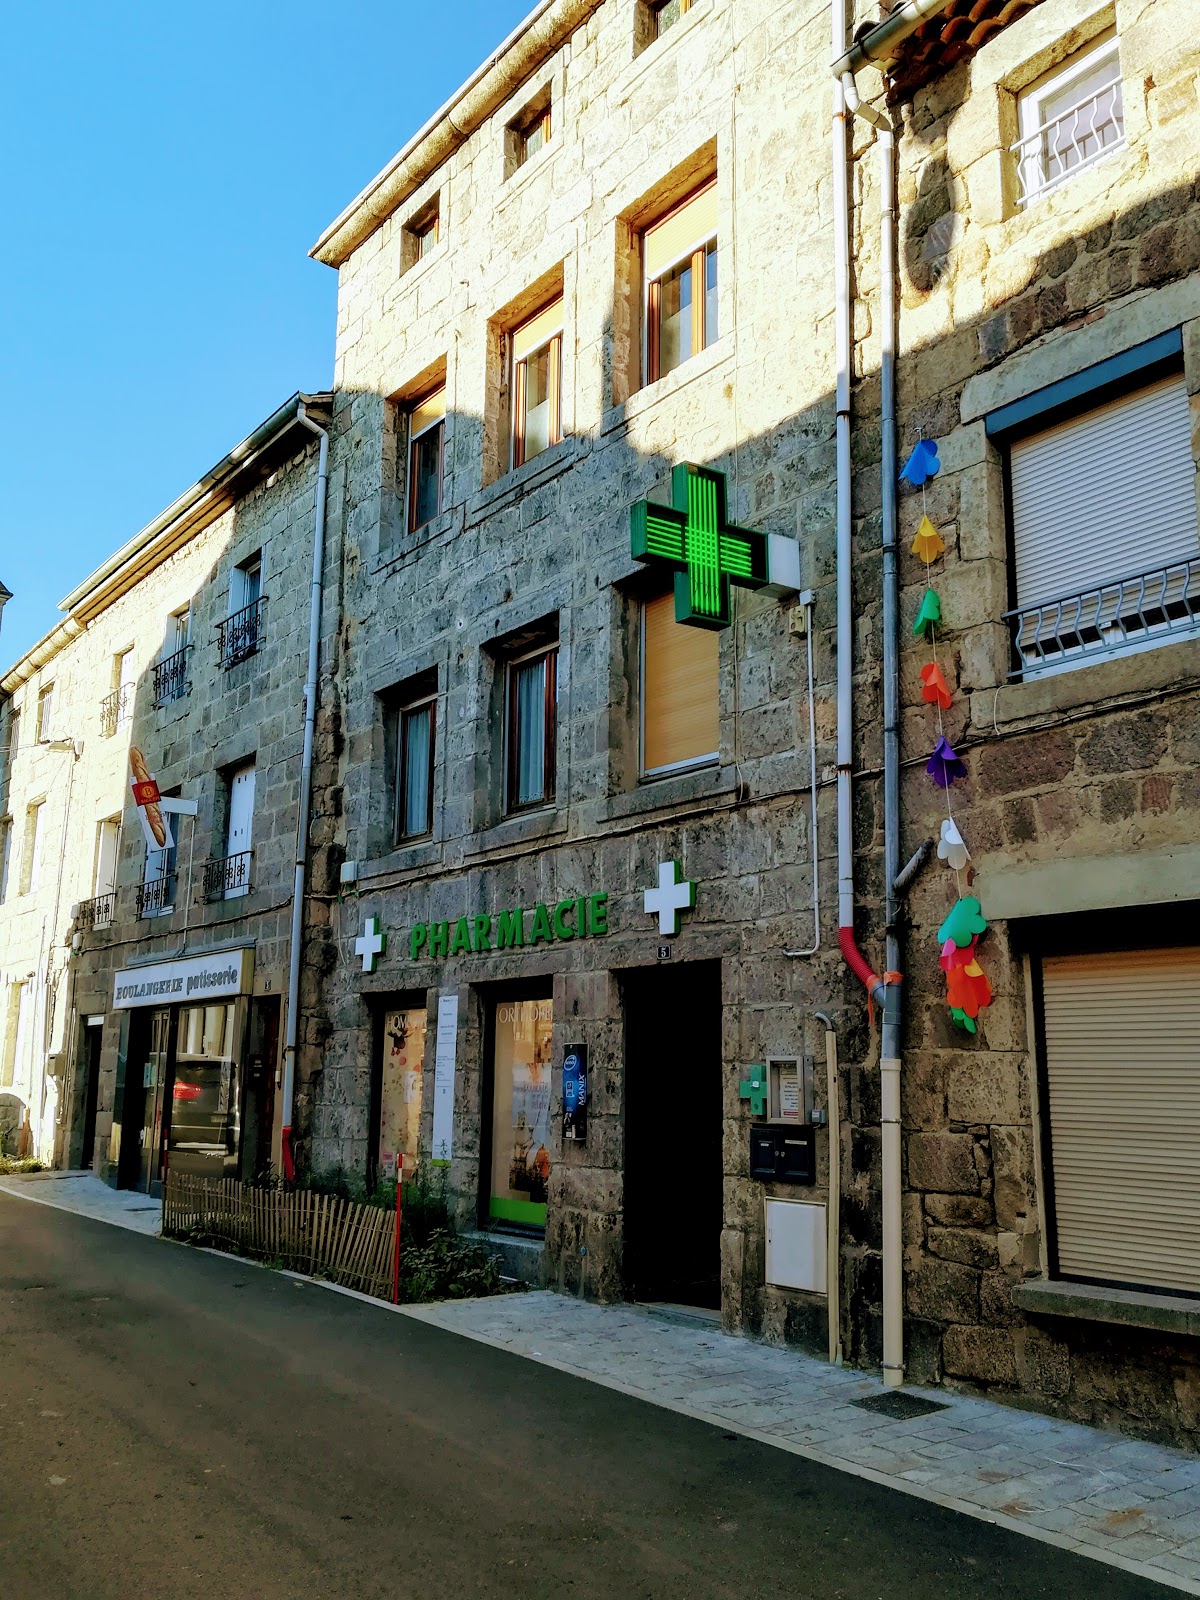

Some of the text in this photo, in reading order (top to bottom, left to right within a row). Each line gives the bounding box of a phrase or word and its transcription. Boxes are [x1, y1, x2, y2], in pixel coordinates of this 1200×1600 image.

[411, 892, 608, 960] PHARMACIE
[660, 946, 667, 958] 5
[115, 977, 184, 1000] BOULANGERIE
[578, 1074, 586, 1106] MANIX
